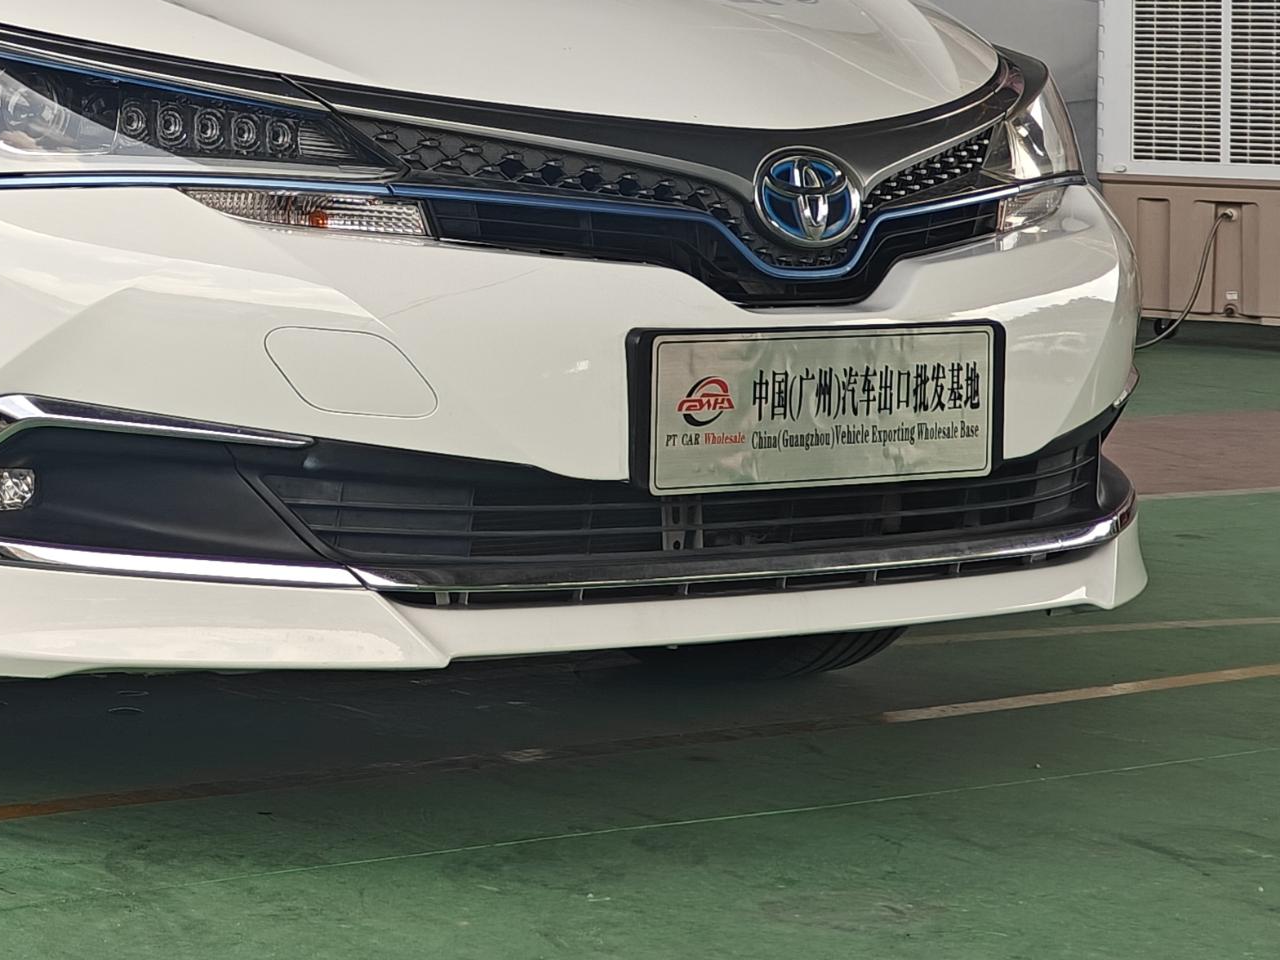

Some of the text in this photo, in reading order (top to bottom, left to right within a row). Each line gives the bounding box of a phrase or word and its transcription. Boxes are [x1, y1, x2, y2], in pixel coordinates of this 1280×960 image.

[752, 360, 981, 422] 中国(广州)汽车出口批发基地
[665, 431, 746, 447] PT CAR Wholesale
[871, 421, 916, 447] Exporting
[917, 420, 959, 441] Wholesale
[960, 419, 980, 438] Base
